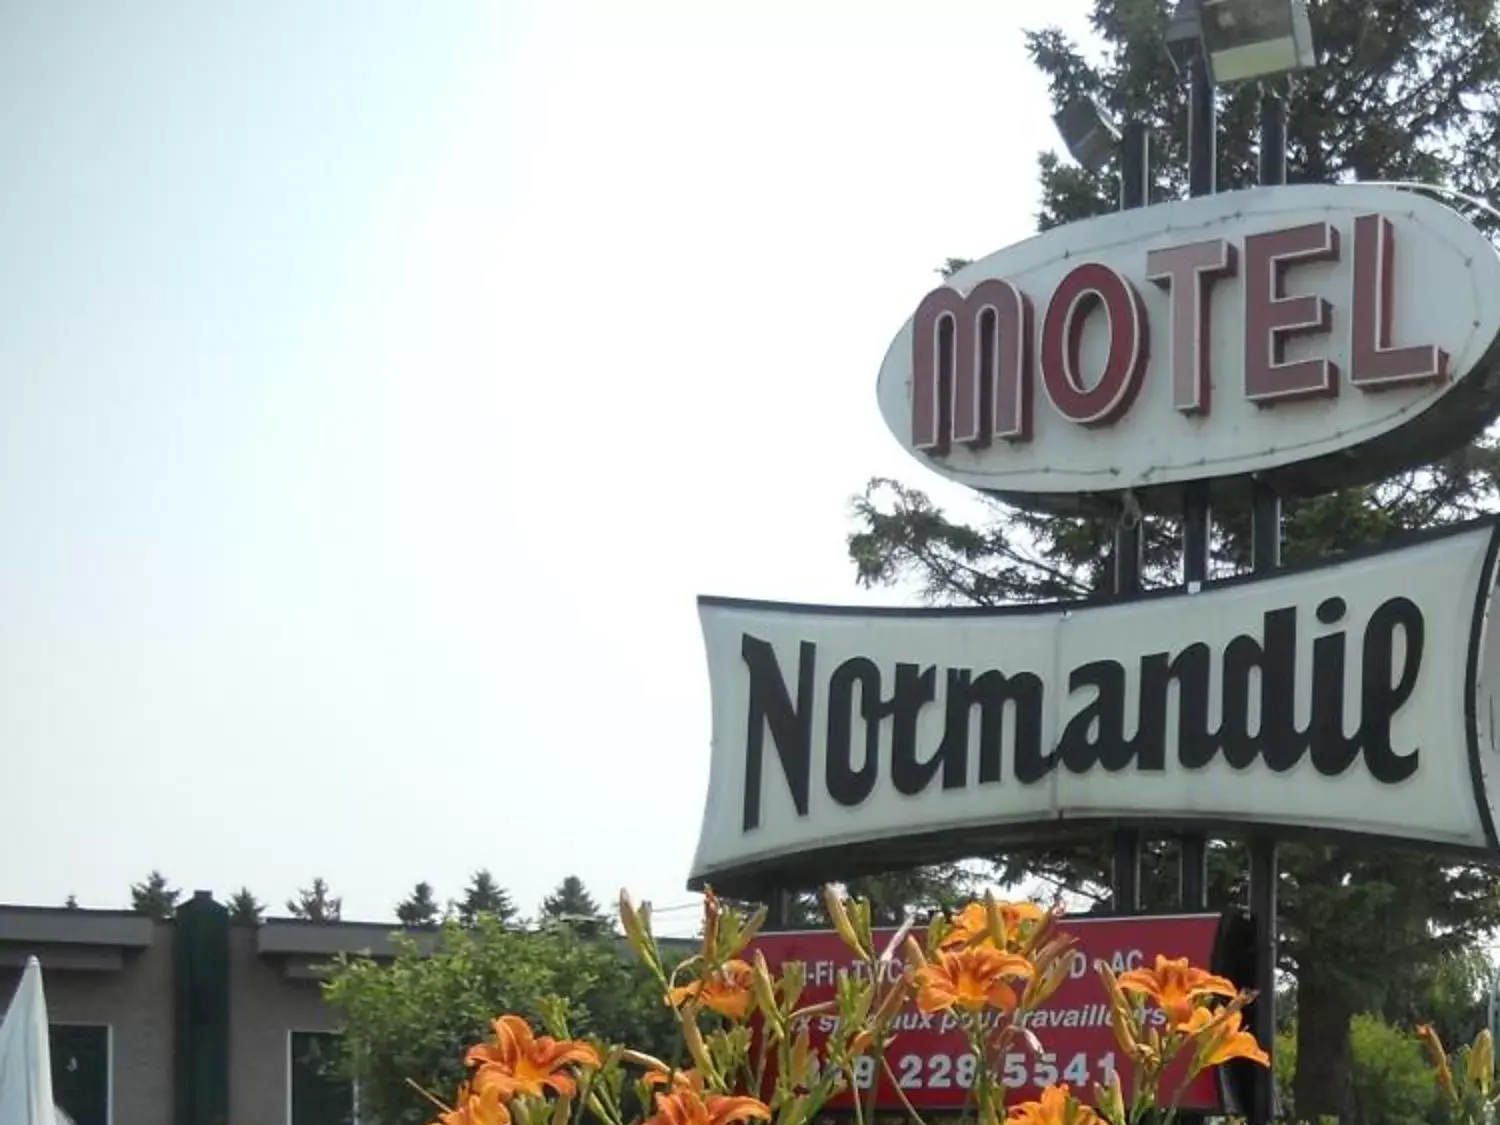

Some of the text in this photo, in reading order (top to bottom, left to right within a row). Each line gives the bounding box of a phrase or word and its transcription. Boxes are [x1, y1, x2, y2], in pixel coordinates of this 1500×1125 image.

[911, 213, 1450, 454] MOTEL
[741, 596, 1425, 832] Normandie
[1111, 949, 1143, 973] AC
[899, 1053, 977, 1089] 228
[1002, 1051, 1117, 1088] 5541
